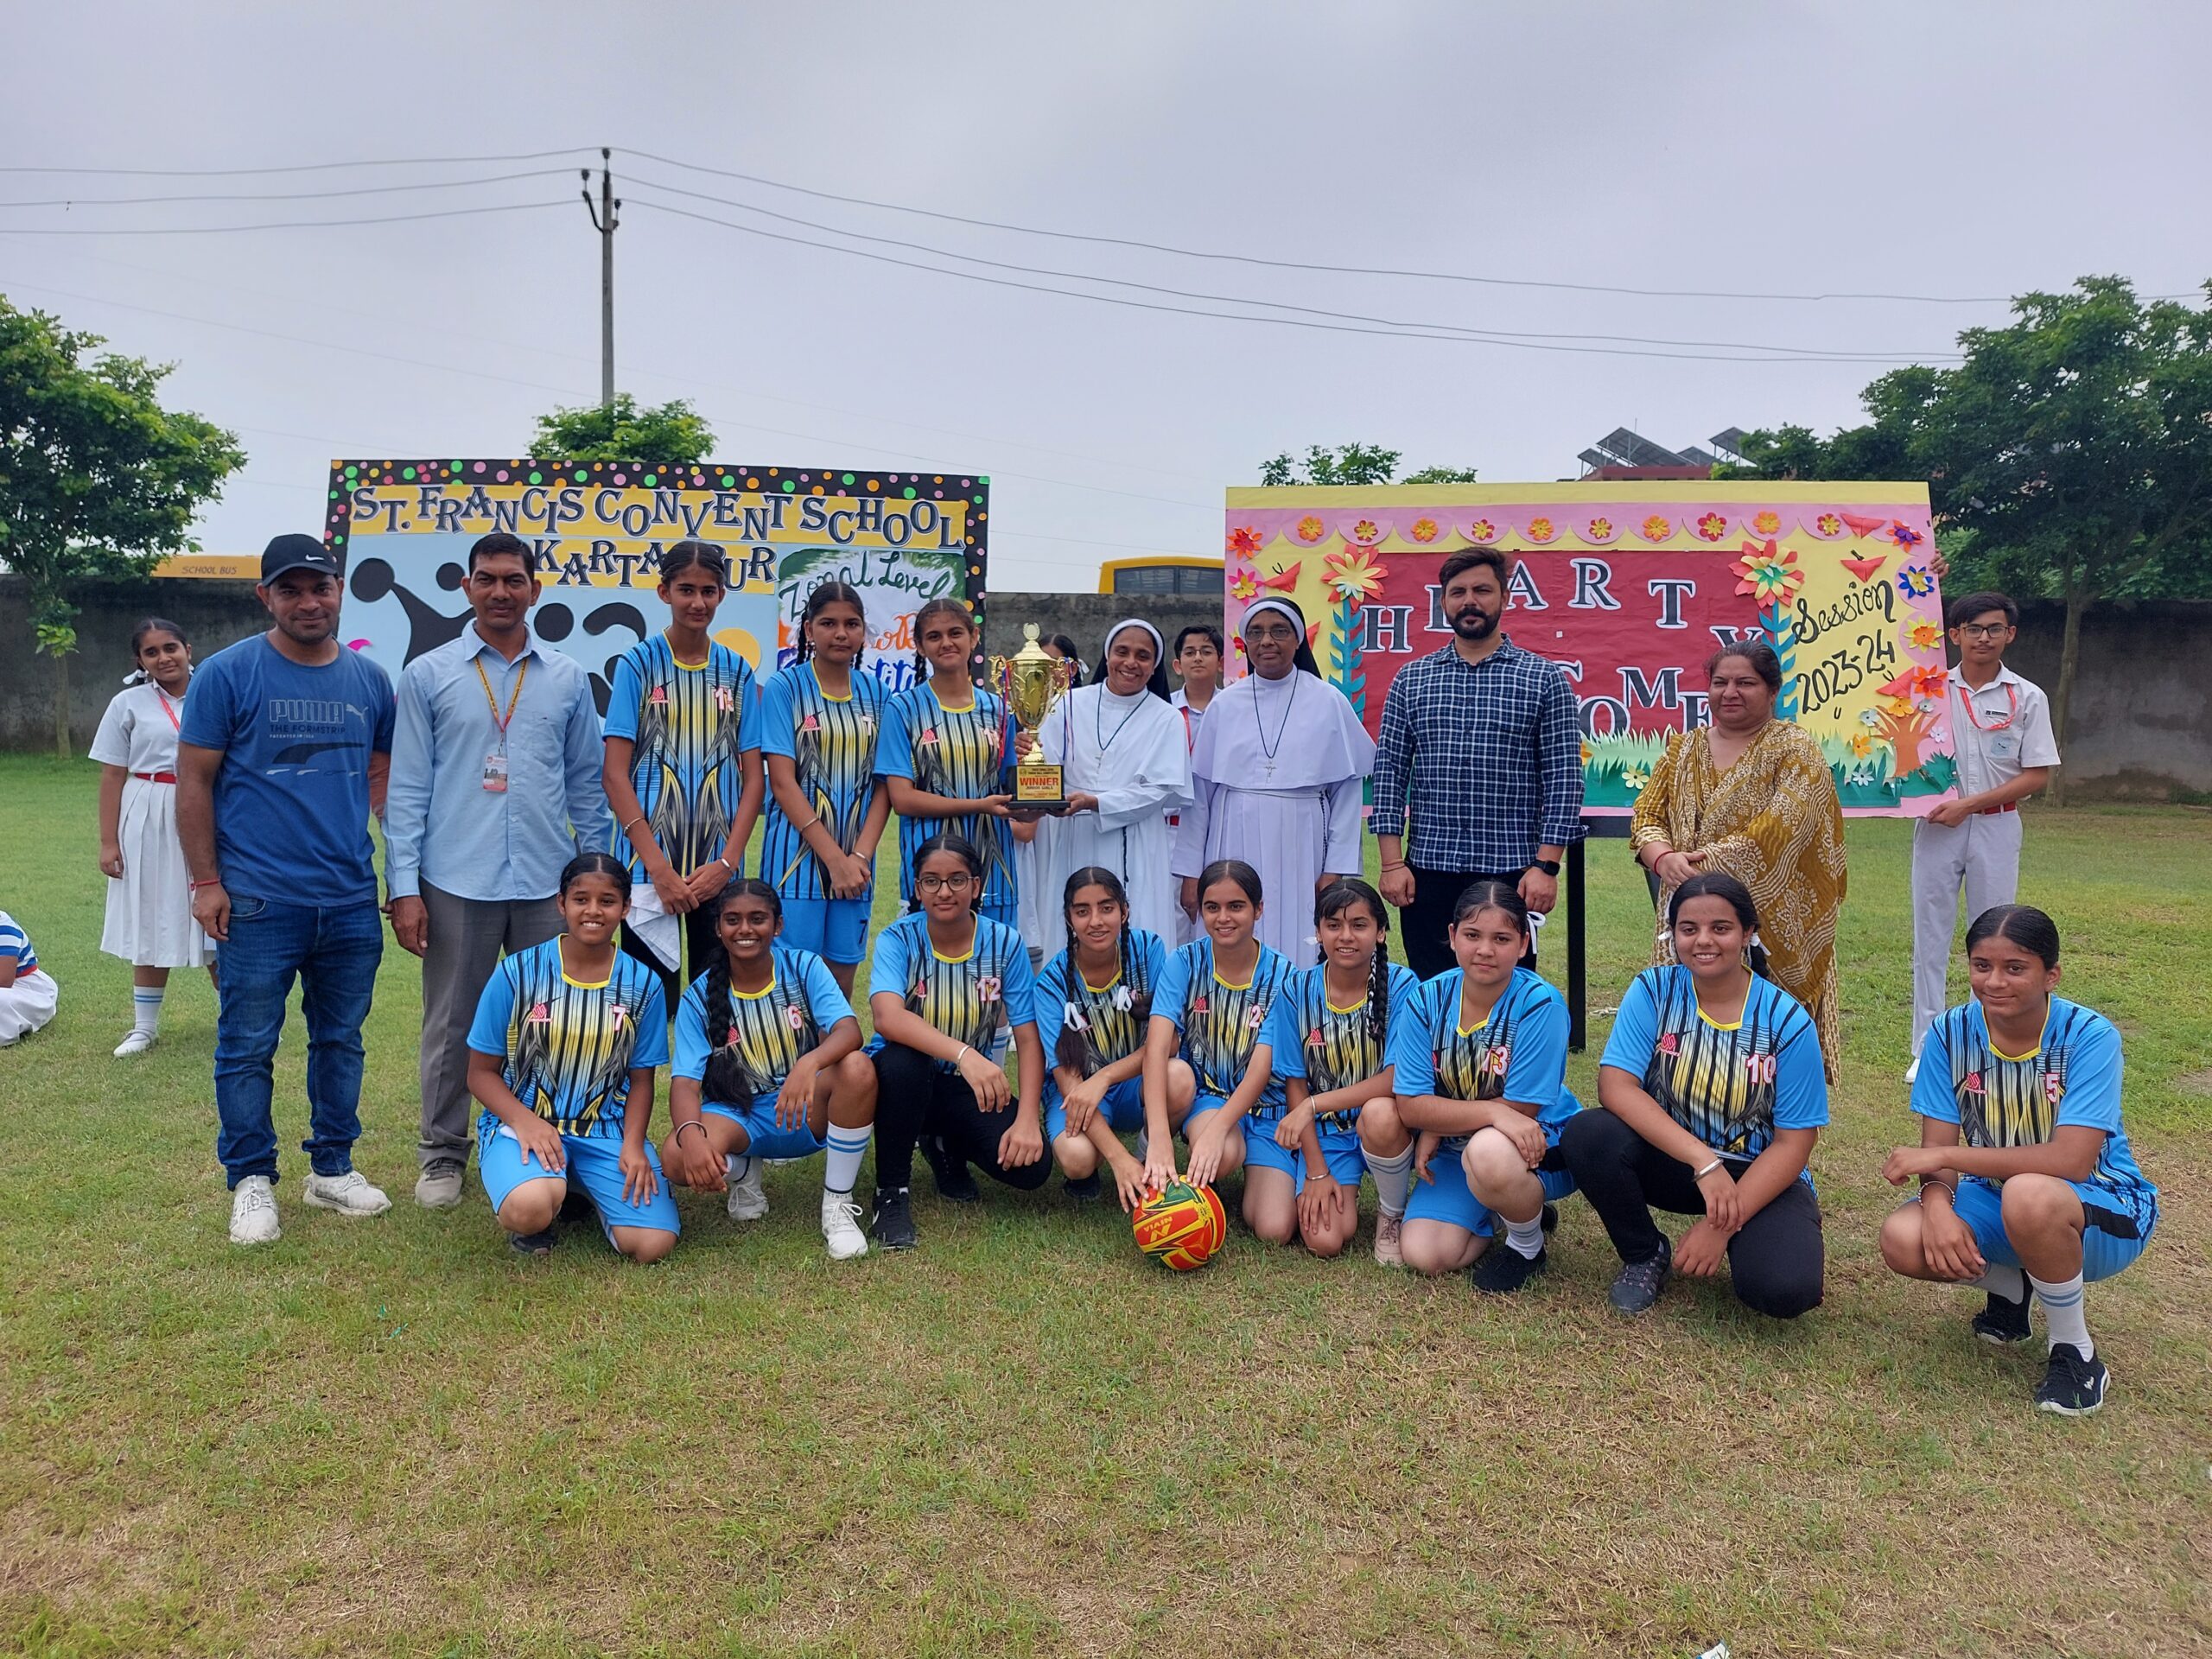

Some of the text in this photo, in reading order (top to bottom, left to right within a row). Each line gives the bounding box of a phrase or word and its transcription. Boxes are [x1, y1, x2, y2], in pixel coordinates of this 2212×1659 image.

[353, 486, 965, 551] ST. FRANCIS CONVENT SCHOOL
[181, 566, 238, 575] SCHOOL BUS
[534, 539, 778, 591] KARTAUR
[878, 550, 950, 601] Level
[1791, 580, 1897, 645] Session
[1796, 628, 1895, 715] 2023-24
[269, 699, 344, 724] PUMA
[270, 724, 346, 734] THE FORMSTRIP
[1020, 777, 1059, 785] WINNER
[976, 977, 1001, 1001] 12
[613, 1005, 627, 1031] 7
[787, 1004, 803, 1029] 6
[1747, 1052, 1777, 1084] 10
[2045, 1072, 2060, 1103] 5
